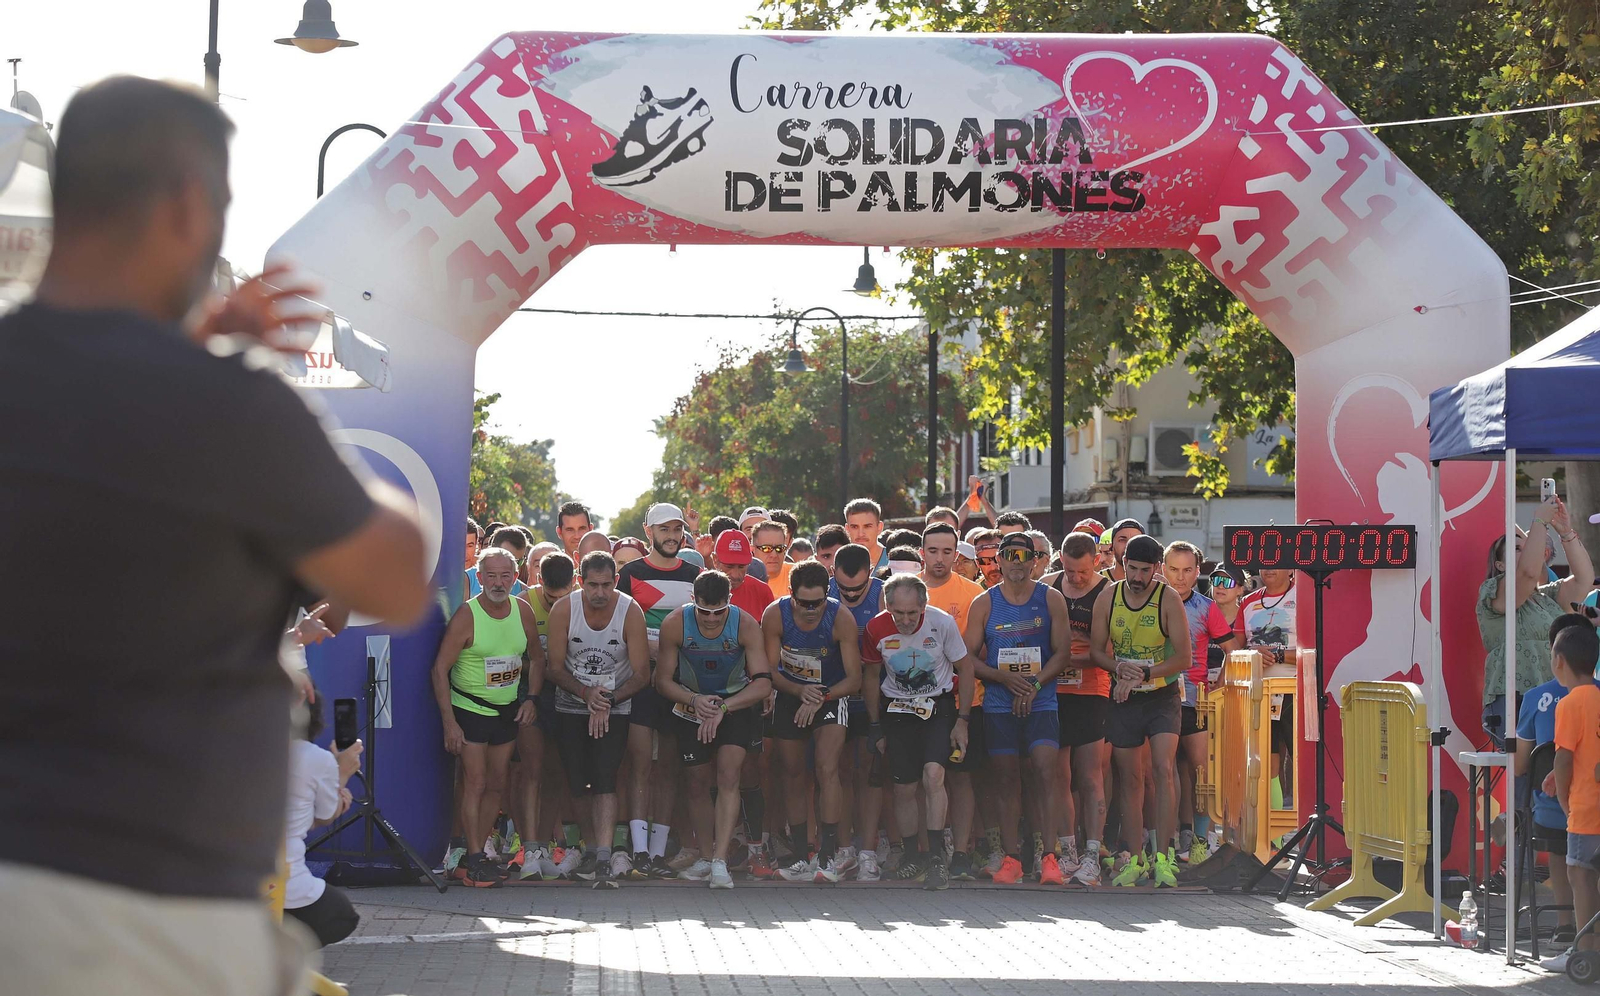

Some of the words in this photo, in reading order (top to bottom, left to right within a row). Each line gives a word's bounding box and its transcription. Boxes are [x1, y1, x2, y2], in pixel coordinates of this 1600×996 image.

[729, 53, 911, 113] Carrera
[776, 117, 1094, 166] SOLIDARIA
[725, 171, 804, 213] DE
[817, 171, 1146, 213] PALMONES
[491, 668, 520, 682] 269
[1009, 664, 1031, 672] 82
